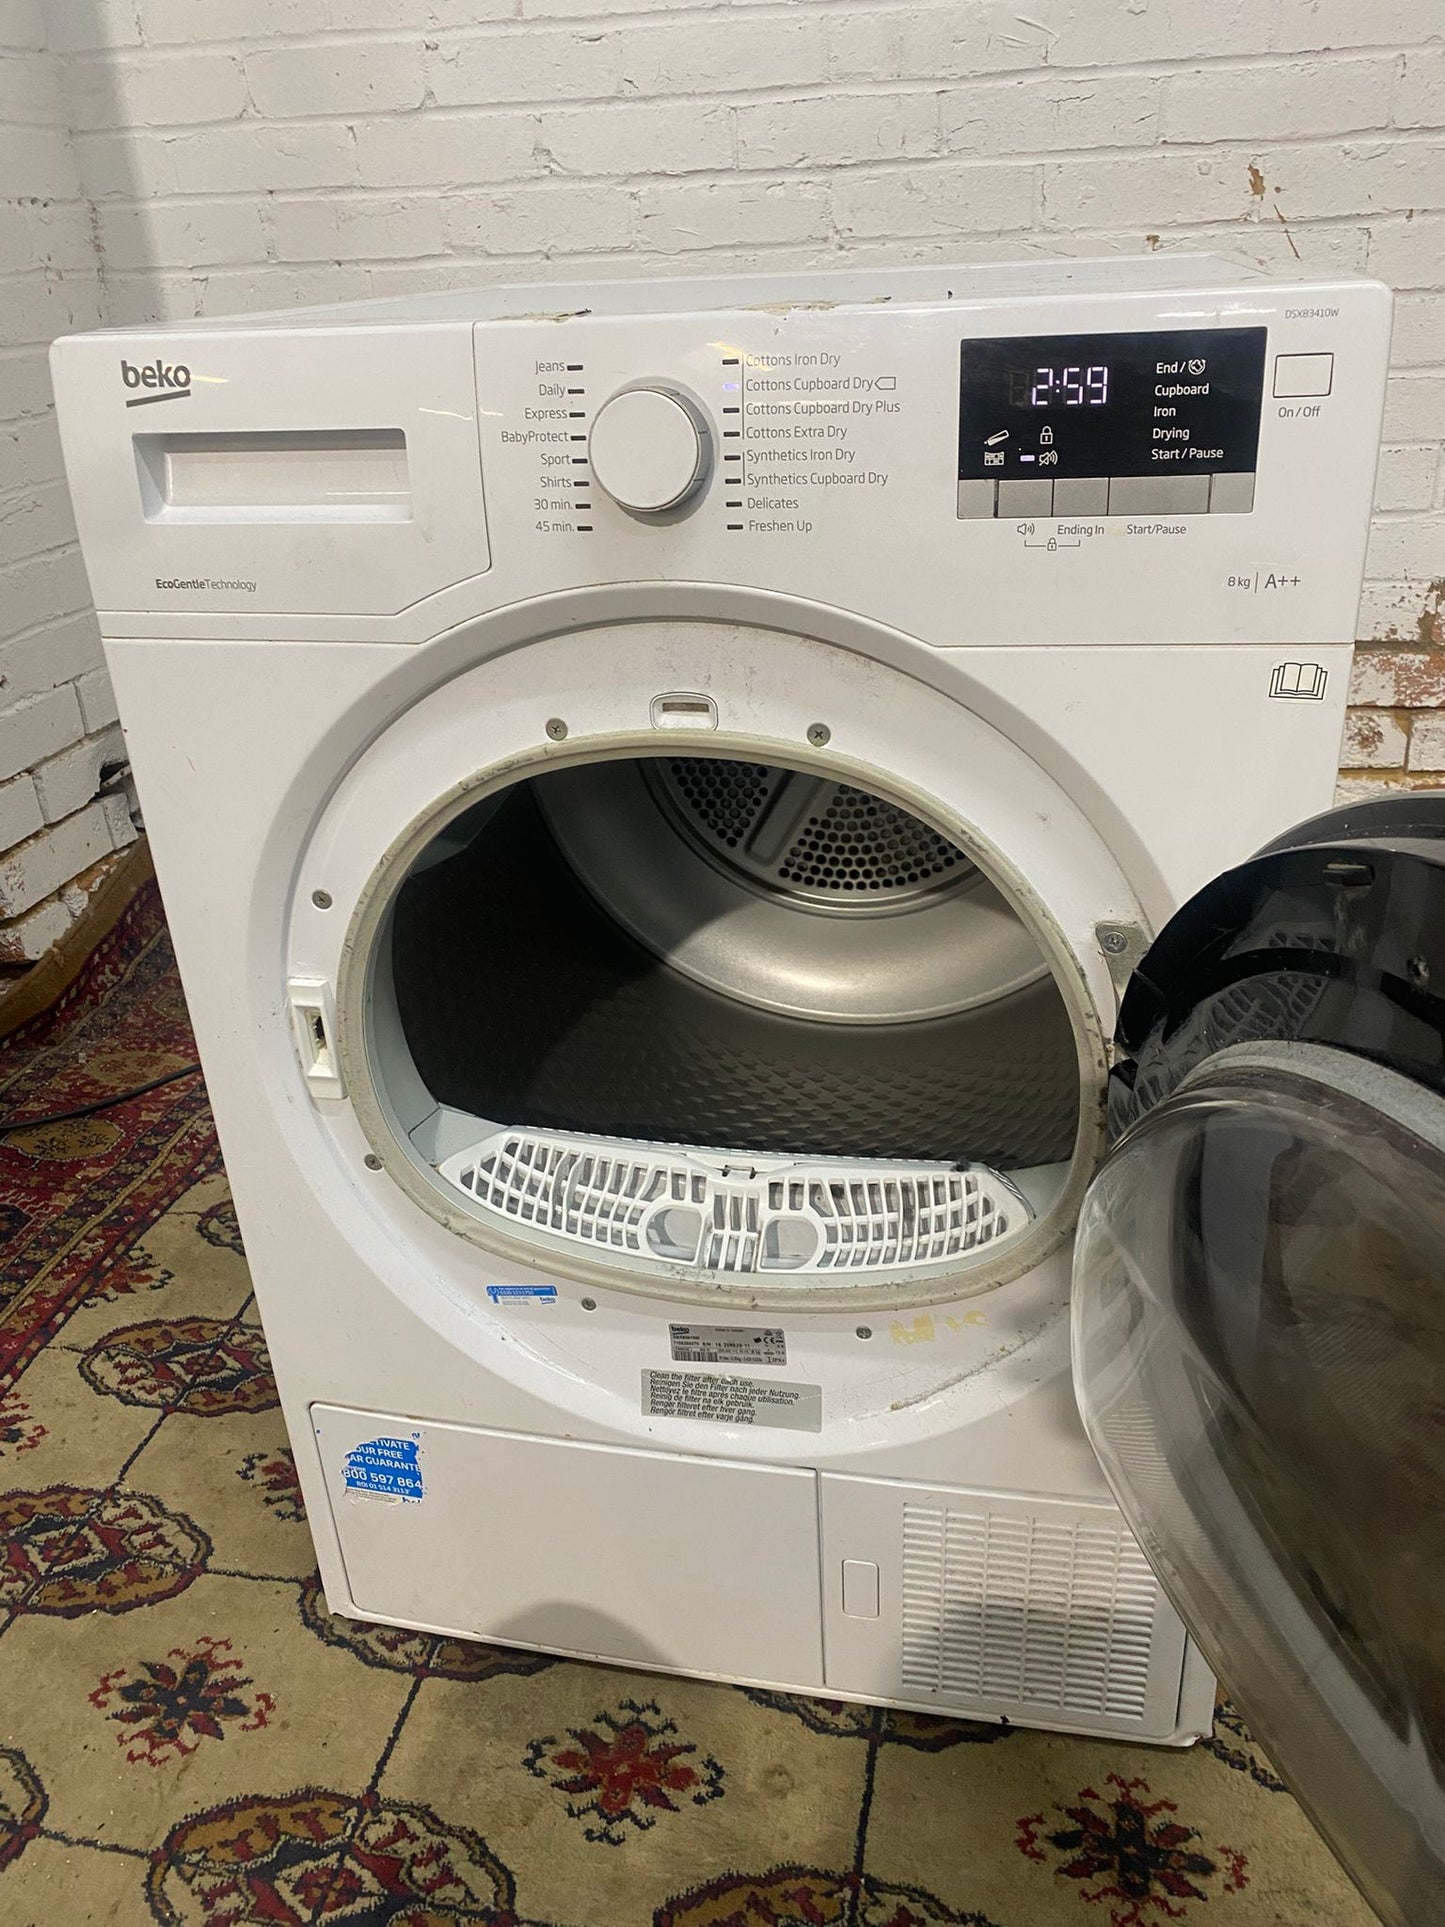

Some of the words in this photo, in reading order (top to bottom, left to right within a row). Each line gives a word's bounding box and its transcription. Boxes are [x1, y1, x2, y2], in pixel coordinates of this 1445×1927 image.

[746, 354, 792, 367] Cottons
[794, 353, 817, 365] Iron
[820, 352, 841, 367] Dry
[121, 360, 191, 388] beko
[535, 360, 565, 374] Jeans
[1156, 362, 1178, 374] End
[539, 384, 566, 396] Daily
[746, 378, 791, 391] Cottons
[794, 377, 850, 392] Cupboard
[853, 377, 873, 391] Dry
[1032, 366, 1108, 405] 2:59
[1154, 383, 1209, 397] Cupboard
[525, 408, 567, 421] Express
[746, 403, 791, 415] Cottons
[794, 402, 850, 416] Cupboard
[852, 401, 873, 416] Dry
[876, 400, 901, 413] Plus
[1153, 406, 1176, 417] Iron
[1278, 406, 1294, 418] On
[1303, 406, 1321, 417] Off
[501, 431, 569, 445] BabyProtect
[746, 427, 791, 439] Cottons
[794, 426, 824, 438] Extra
[827, 425, 847, 440] Dry
[1152, 427, 1190, 441] Drying
[541, 453, 571, 467] Sport
[747, 449, 807, 464] Synthetics
[810, 449, 832, 461] Iron
[835, 448, 855, 463] Dry
[1151, 449, 1179, 460] Start
[1189, 448, 1224, 459] Pause
[540, 476, 572, 488] Shirts
[747, 473, 808, 488] Synthetics
[810, 472, 865, 487] Cupboard
[868, 472, 888, 486] Dry
[534, 499, 548, 510] 30
[551, 499, 573, 510] min.
[747, 497, 799, 509] Delicates
[535, 521, 549, 531] 45
[552, 521, 574, 532] min.
[749, 520, 794, 532] Freshen
[796, 520, 812, 533] Up
[1057, 524, 1093, 538] Ending
[1095, 524, 1104, 535] In
[1127, 524, 1187, 535] Start/Pause
[156, 579, 257, 592] EcoGentleTechnology
[1227, 576, 1236, 586] 8
[1238, 577, 1251, 589] kg
[1264, 574, 1301, 589] A++
[650, 1371, 669, 1379] Clean
[671, 1373, 682, 1381] the
[684, 1374, 701, 1382] filter
[702, 1376, 719, 1385] after
[721, 1378, 738, 1386] each
[650, 1378, 681, 1388] Reinigen
[682, 1380, 693, 1388] Sie
[710, 1383, 729, 1392] Filter
[730, 1385, 747, 1393] nach
[748, 1387, 768, 1396] jeder
[650, 1385, 681, 1395] Nettoyez
[730, 1393, 756, 1402] chaque
[650, 1392, 672, 1400] Reinig
[685, 1395, 701, 1403] filter
[701, 1403, 719, 1412] efter
[720, 1405, 735, 1413] hver
[698, 1410, 714, 1418] efter
[716, 1413, 733, 1422] varje
[378, 1449, 403, 1459] FREE
[370, 1472, 393, 1484] 597
[397, 1477, 422, 1489] 864
